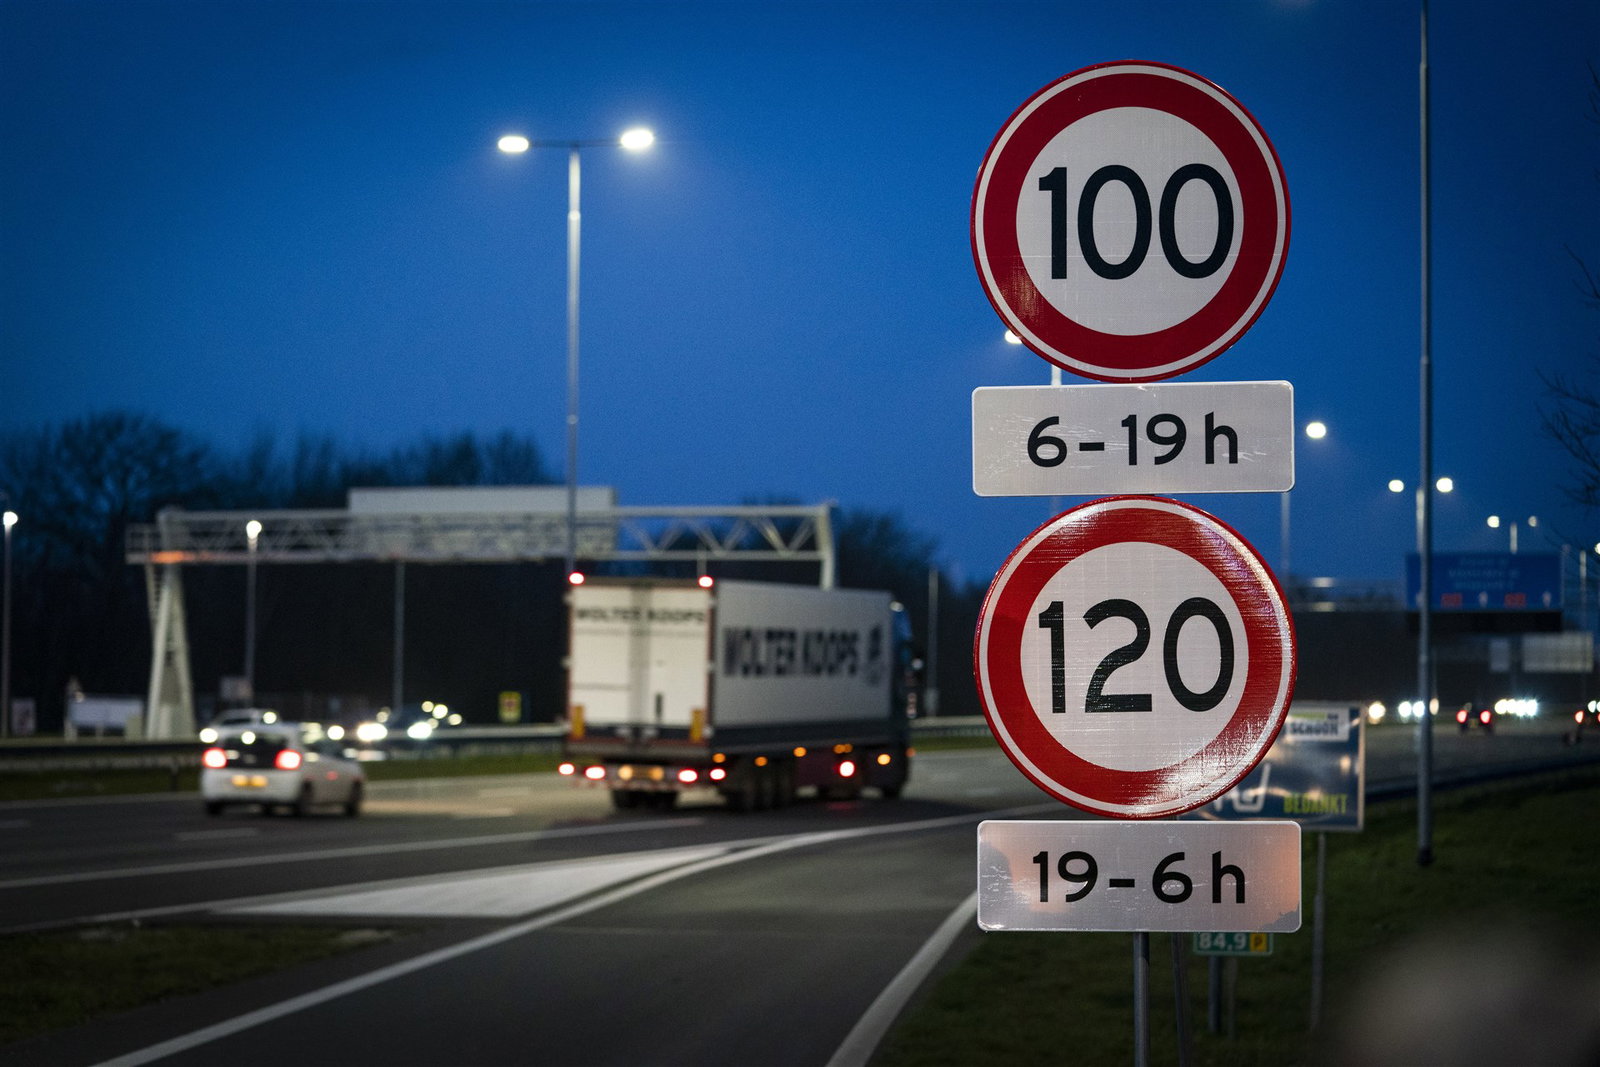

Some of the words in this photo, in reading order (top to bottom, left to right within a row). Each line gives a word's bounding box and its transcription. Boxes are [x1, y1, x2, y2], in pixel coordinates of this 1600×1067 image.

[1038, 163, 1235, 280] 100
[1204, 411, 1239, 465] h
[1038, 596, 1235, 714] 120
[1211, 850, 1246, 904] h
